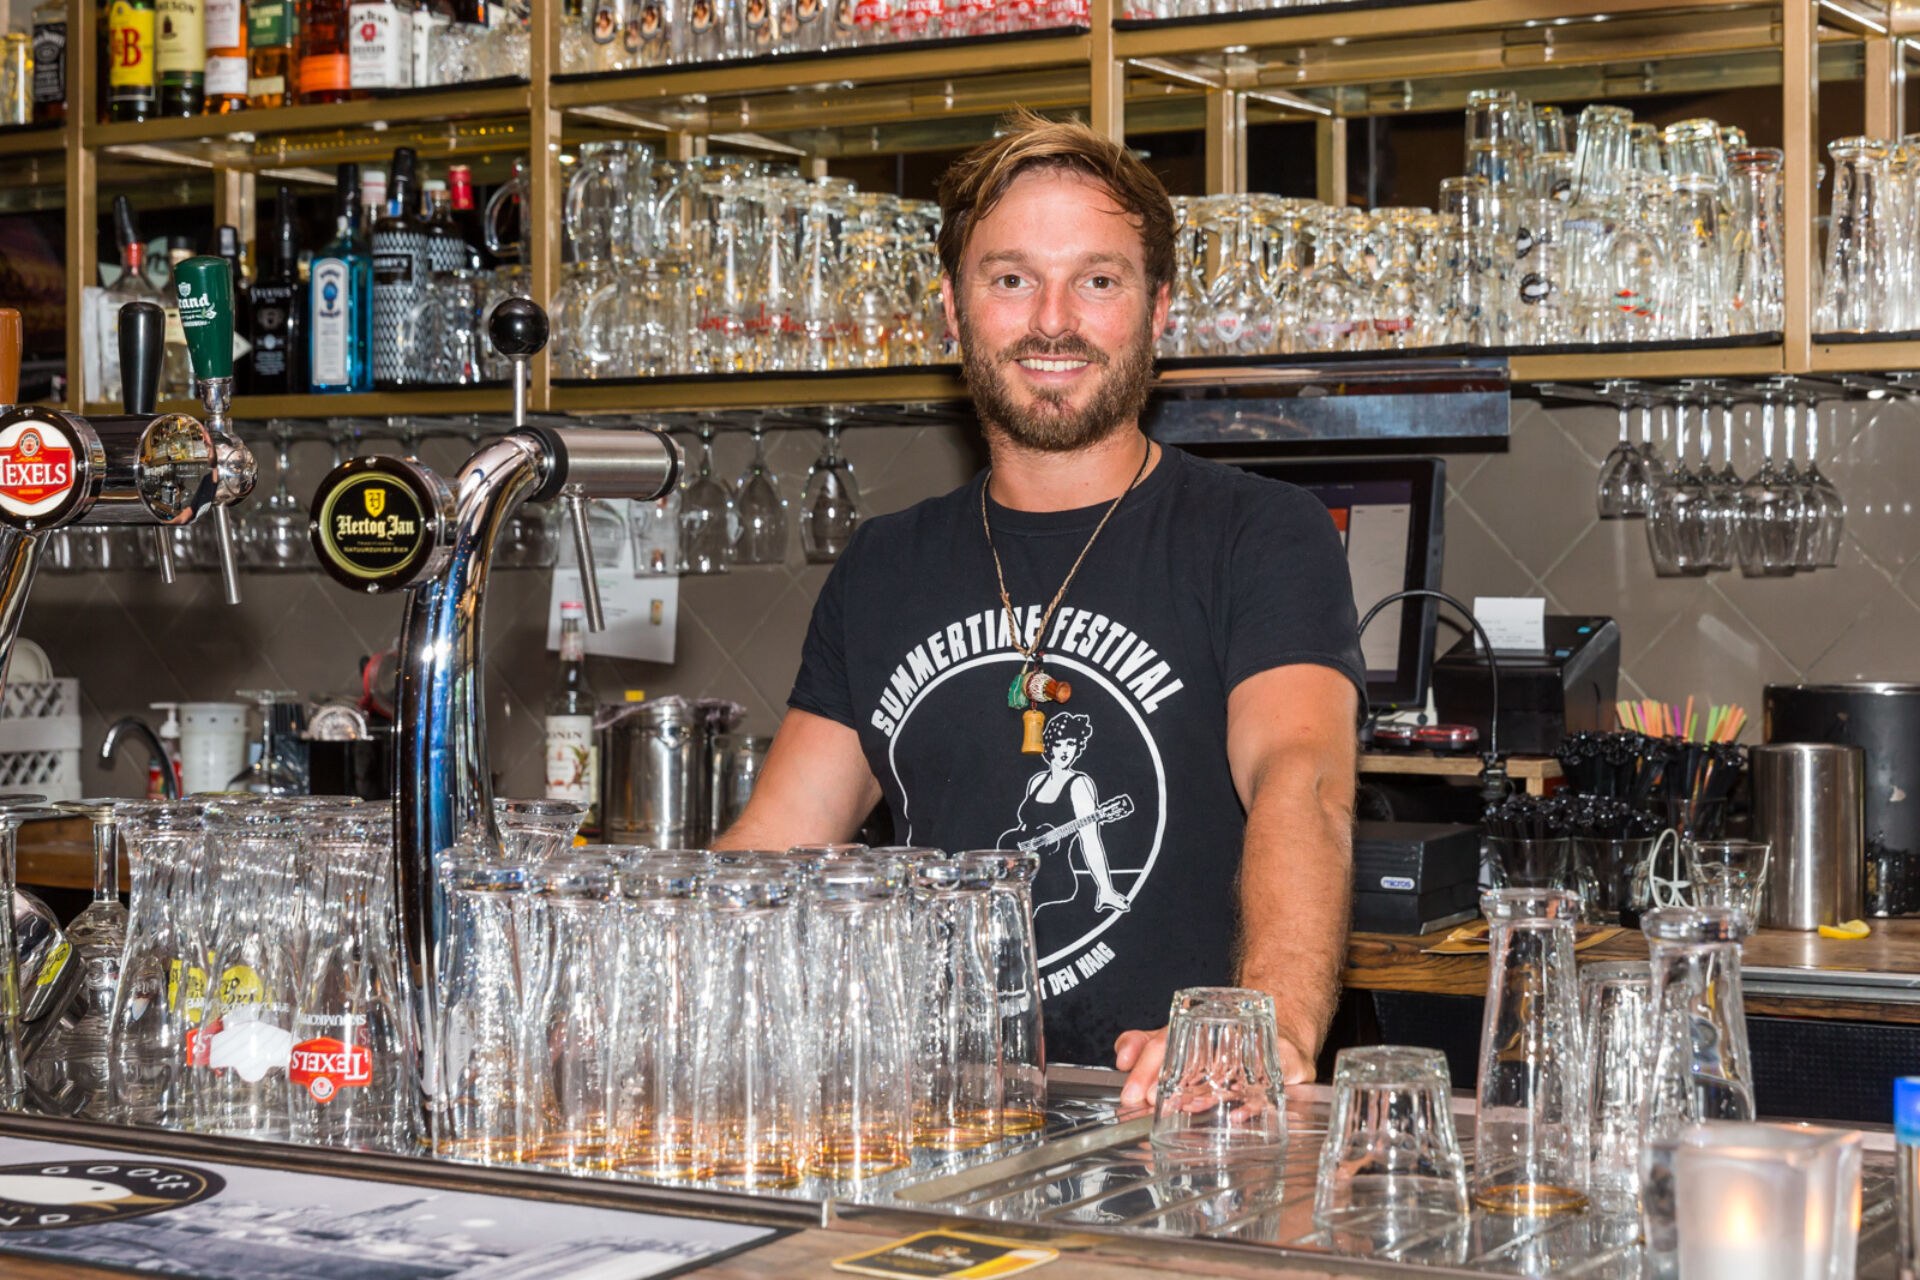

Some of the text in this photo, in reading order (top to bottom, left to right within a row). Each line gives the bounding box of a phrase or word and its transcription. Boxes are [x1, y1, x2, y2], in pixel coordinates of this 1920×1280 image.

[336, 514, 415, 540] Hertog Jan
[871, 604, 1184, 737] SUMMERTIME FESTIVAL
[1047, 964, 1080, 996] DEN
[1075, 941, 1116, 979] HAAG
[292, 1051, 370, 1080] TEXELS
[40, 1166, 190, 1190] GOOSE
